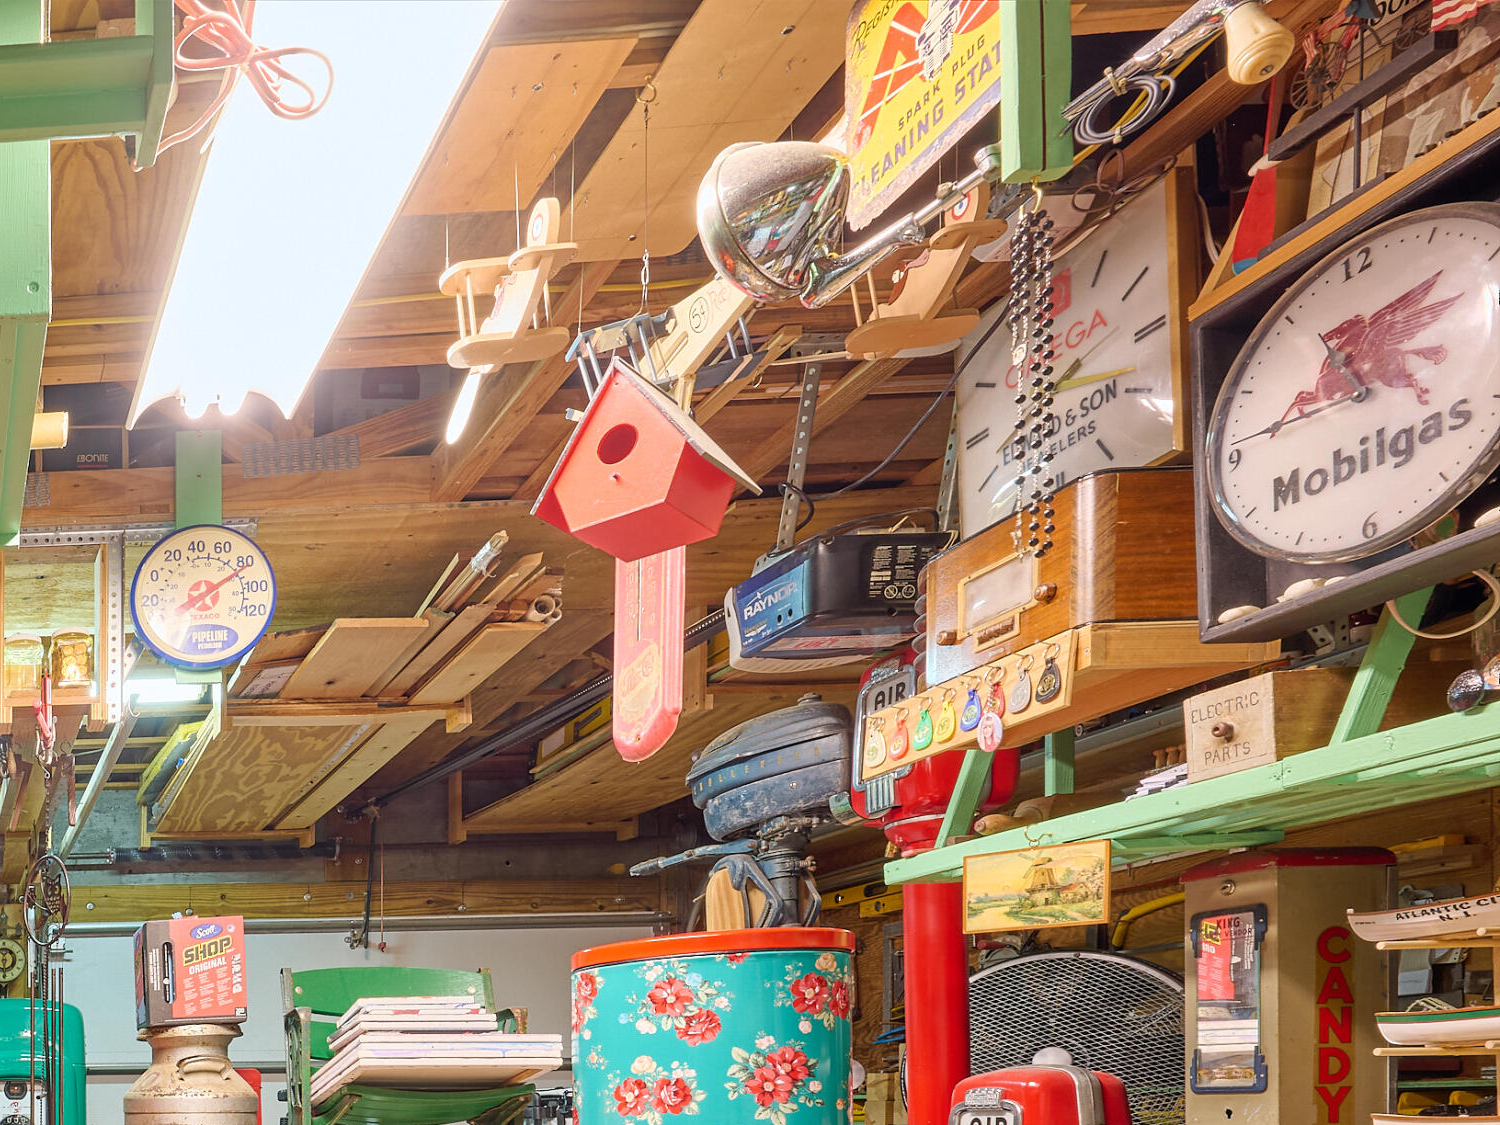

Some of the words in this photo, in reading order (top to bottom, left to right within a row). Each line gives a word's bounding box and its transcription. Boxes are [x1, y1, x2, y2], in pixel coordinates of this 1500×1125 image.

[898, 80, 940, 131] SPARK
[952, 34, 986, 75] PLUG
[1340, 246, 1373, 283] 12
[1065, 408, 1077, 426] &
[1079, 379, 1117, 419] SON
[1021, 420, 1097, 472] JEELERS
[1273, 397, 1473, 512] Mobilgas
[1228, 448, 1242, 473] 9
[1362, 511, 1379, 539] 6
[163, 549, 182, 562] 20
[236, 554, 254, 568] 80
[188, 540, 205, 553] 40
[213, 541, 232, 554] 60
[150, 569, 159, 582] 0
[245, 579, 268, 593] 100
[141, 594, 159, 607] 20
[243, 603, 267, 617] 120
[743, 581, 798, 620] RAYNOR
[190, 612, 221, 621] TEXACO
[192, 629, 228, 643] PIPELINE
[874, 682, 907, 712] AIR
[1191, 691, 1260, 724] ELECTRIC
[1204, 741, 1252, 766] PARTS
[1395, 901, 1471, 921] ATLANTIC
[195, 924, 218, 939] Scott
[183, 935, 232, 966] SHOP
[188, 956, 227, 975] ORIGINAL
[1315, 926, 1355, 1123] CANDY
